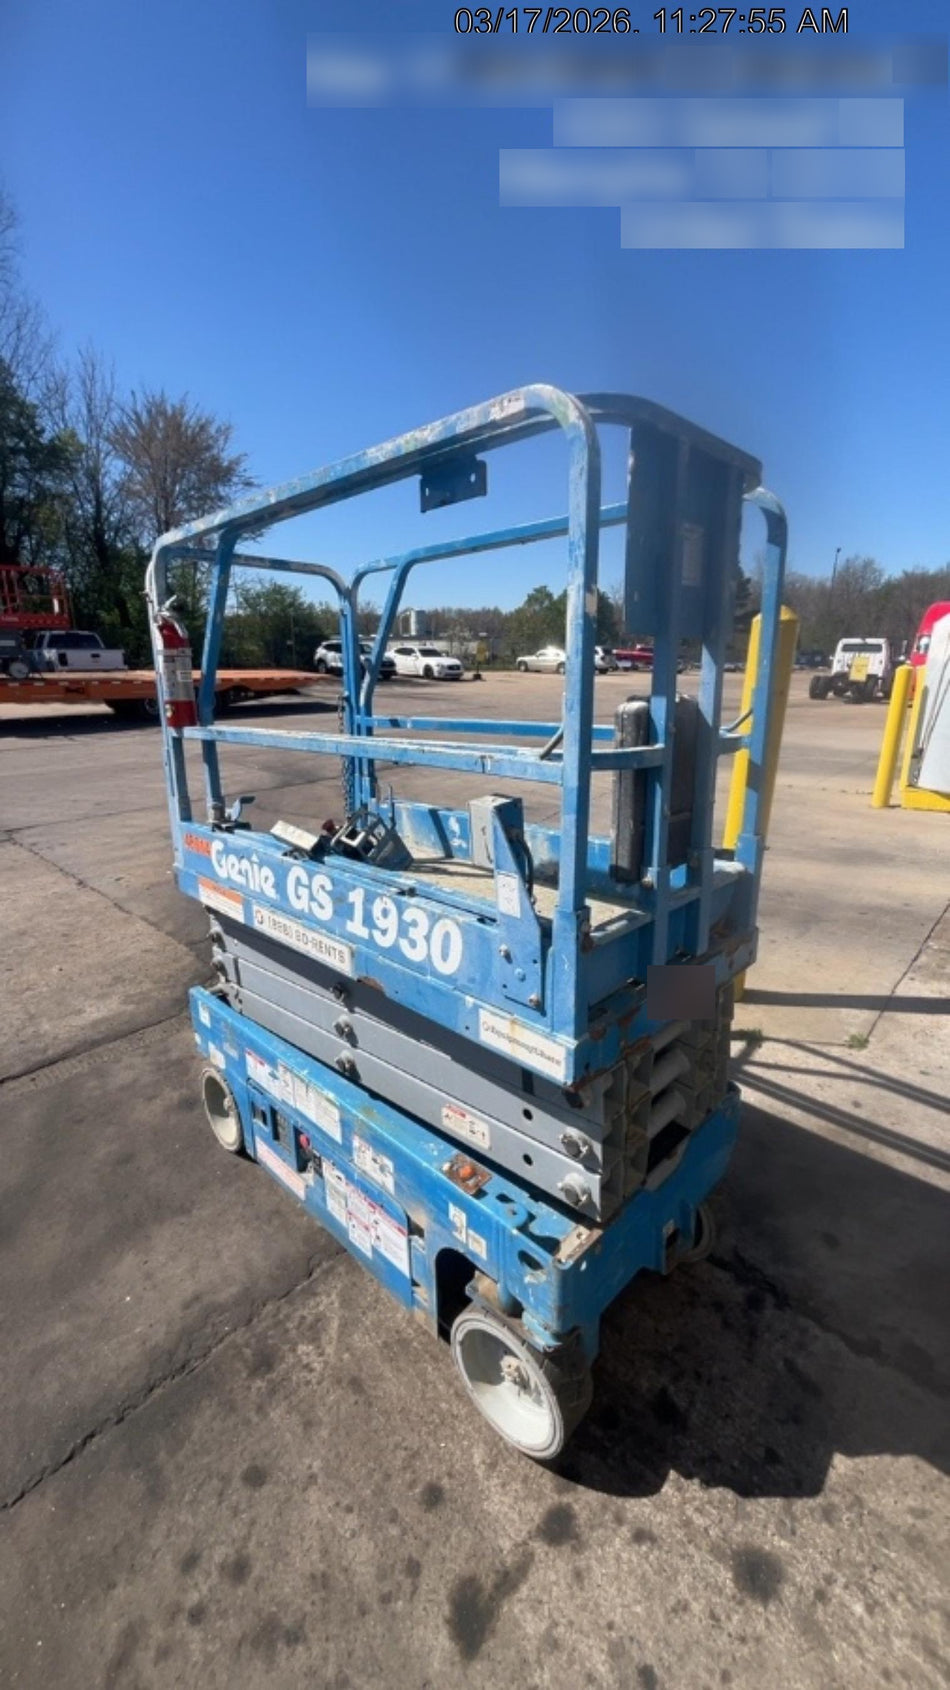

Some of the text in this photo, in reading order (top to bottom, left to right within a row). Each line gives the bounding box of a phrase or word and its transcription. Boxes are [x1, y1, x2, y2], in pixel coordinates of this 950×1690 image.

[211, 840, 277, 899] Genie
[287, 865, 333, 921] GS
[346, 887, 463, 975] 1930
